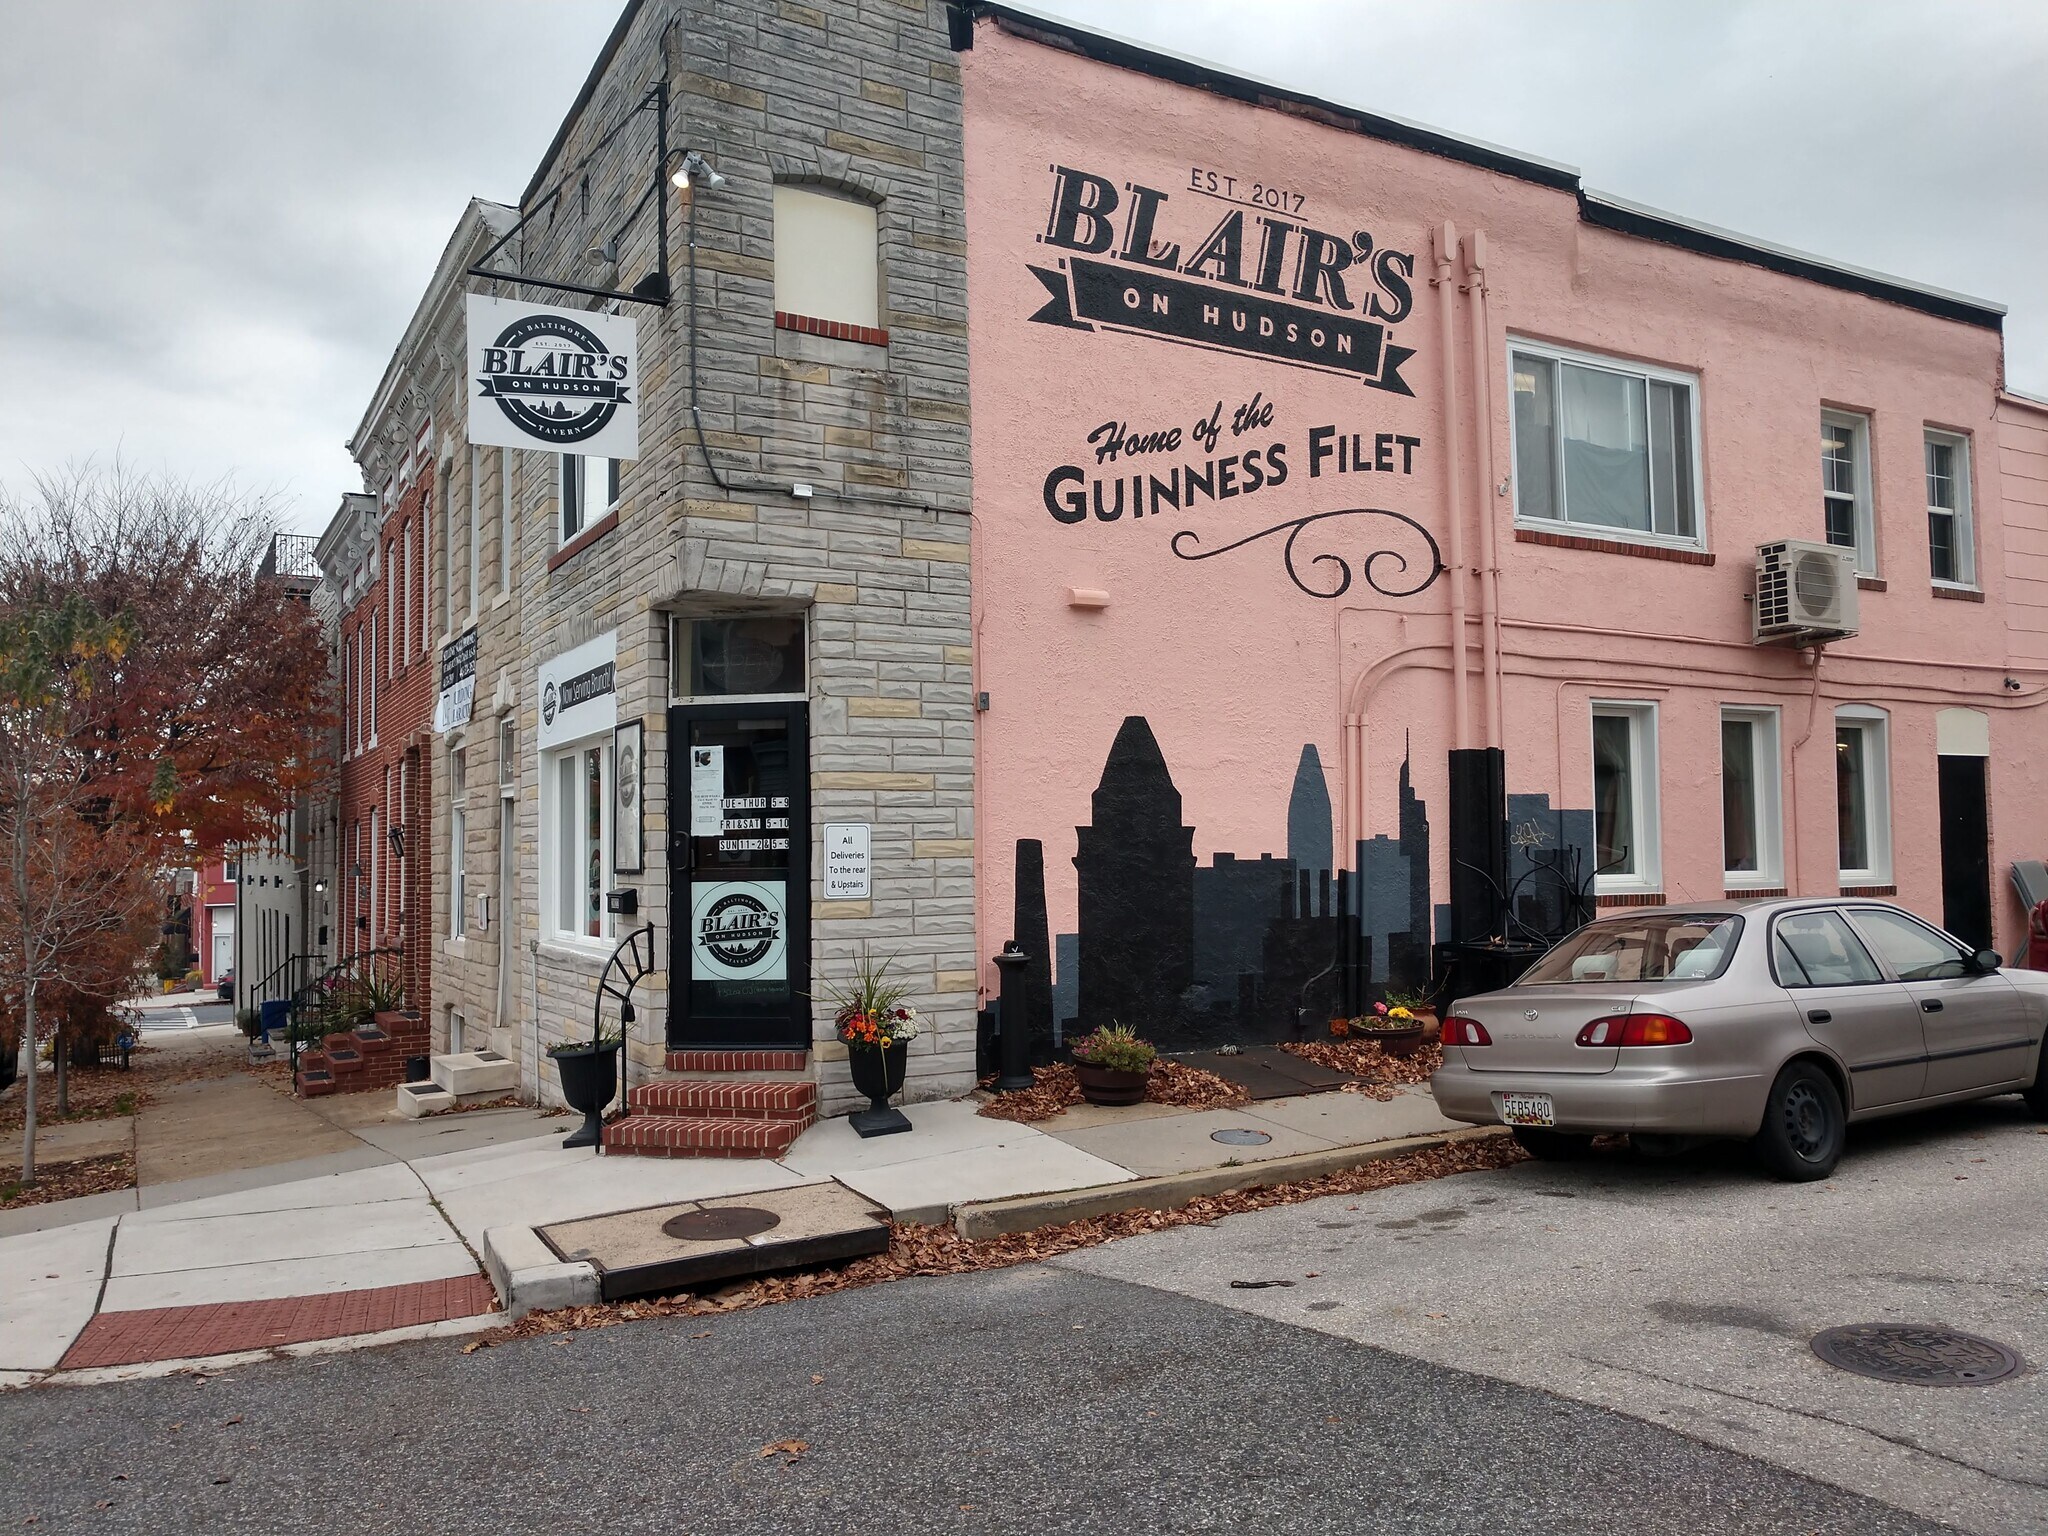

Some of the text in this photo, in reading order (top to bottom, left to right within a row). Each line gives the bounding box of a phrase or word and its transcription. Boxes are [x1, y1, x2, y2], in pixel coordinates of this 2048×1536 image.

[1191, 167, 1305, 213] EST. 2017
[1036, 163, 1415, 325] BLAIR'S
[1123, 287, 1352, 354] ON HUDSON
[526, 322, 587, 342] BALTIMORE
[479, 348, 629, 380] BLAIR'S
[512, 380, 600, 392] ON HUDSON
[538, 425, 581, 436] TAVERN
[1087, 391, 1275, 465] Home of the
[1043, 425, 1421, 525] GUINNESS FILET
[573, 677, 591, 701] Serving
[720, 840, 737, 850] SUN
[842, 836, 853, 845] All
[831, 851, 865, 860] Deliveries
[829, 866, 838, 874] To
[840, 866, 851, 874] the
[831, 880, 864, 890] & Upstairs
[699, 911, 779, 933] BLAIR'S
[1505, 1100, 1550, 1117] 5EB5480
